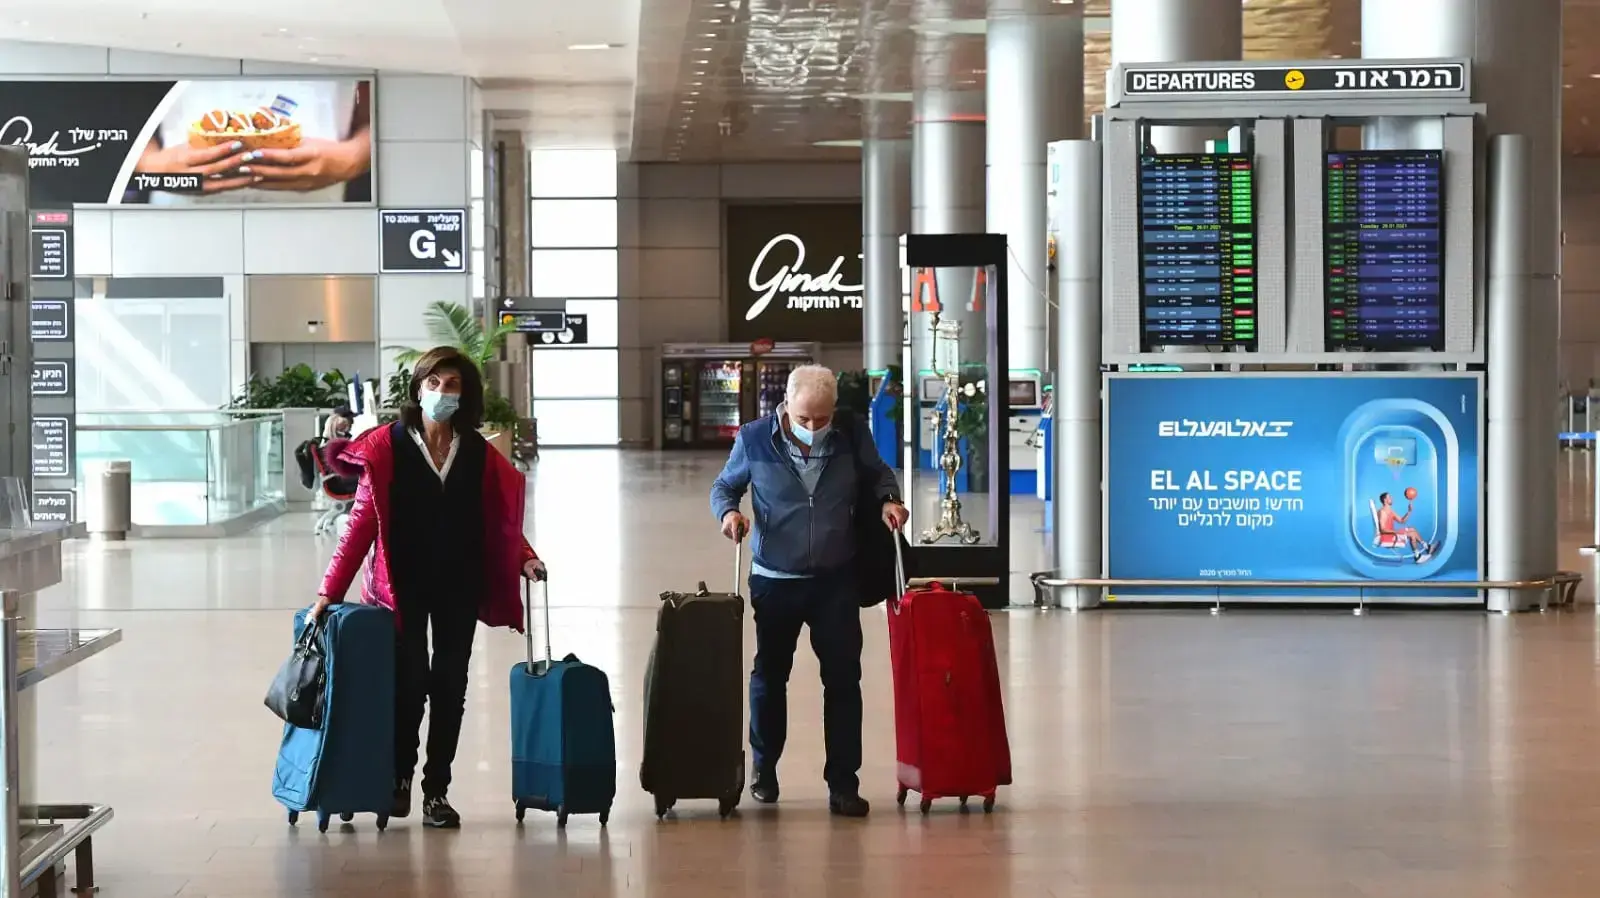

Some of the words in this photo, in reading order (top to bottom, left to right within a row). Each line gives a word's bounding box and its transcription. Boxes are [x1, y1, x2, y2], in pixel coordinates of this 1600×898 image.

[1133, 72, 1256, 90] DEPARTURES
[1334, 69, 1452, 88] המראות
[68, 126, 95, 144] שלך
[97, 129, 128, 141] הבית
[28, 157, 57, 169] החזקו
[134, 173, 161, 191] שלך
[163, 176, 198, 188] הטעם
[384, 215, 396, 223] TO
[397, 215, 420, 223] ZONE
[427, 213, 460, 223] מעליות
[409, 229, 436, 259] G
[786, 295, 840, 312] החזקות
[1151, 470, 1180, 491] EL
[1186, 470, 1218, 491] AL
[1224, 470, 1303, 491] SPACE
[1148, 497, 1177, 511] יותר
[1182, 497, 1203, 512] עם
[1208, 497, 1261, 511] מושבים
[1265, 497, 1304, 511] חדש!
[1178, 511, 1231, 527] לרגליים
[1236, 513, 1274, 530] מקום
